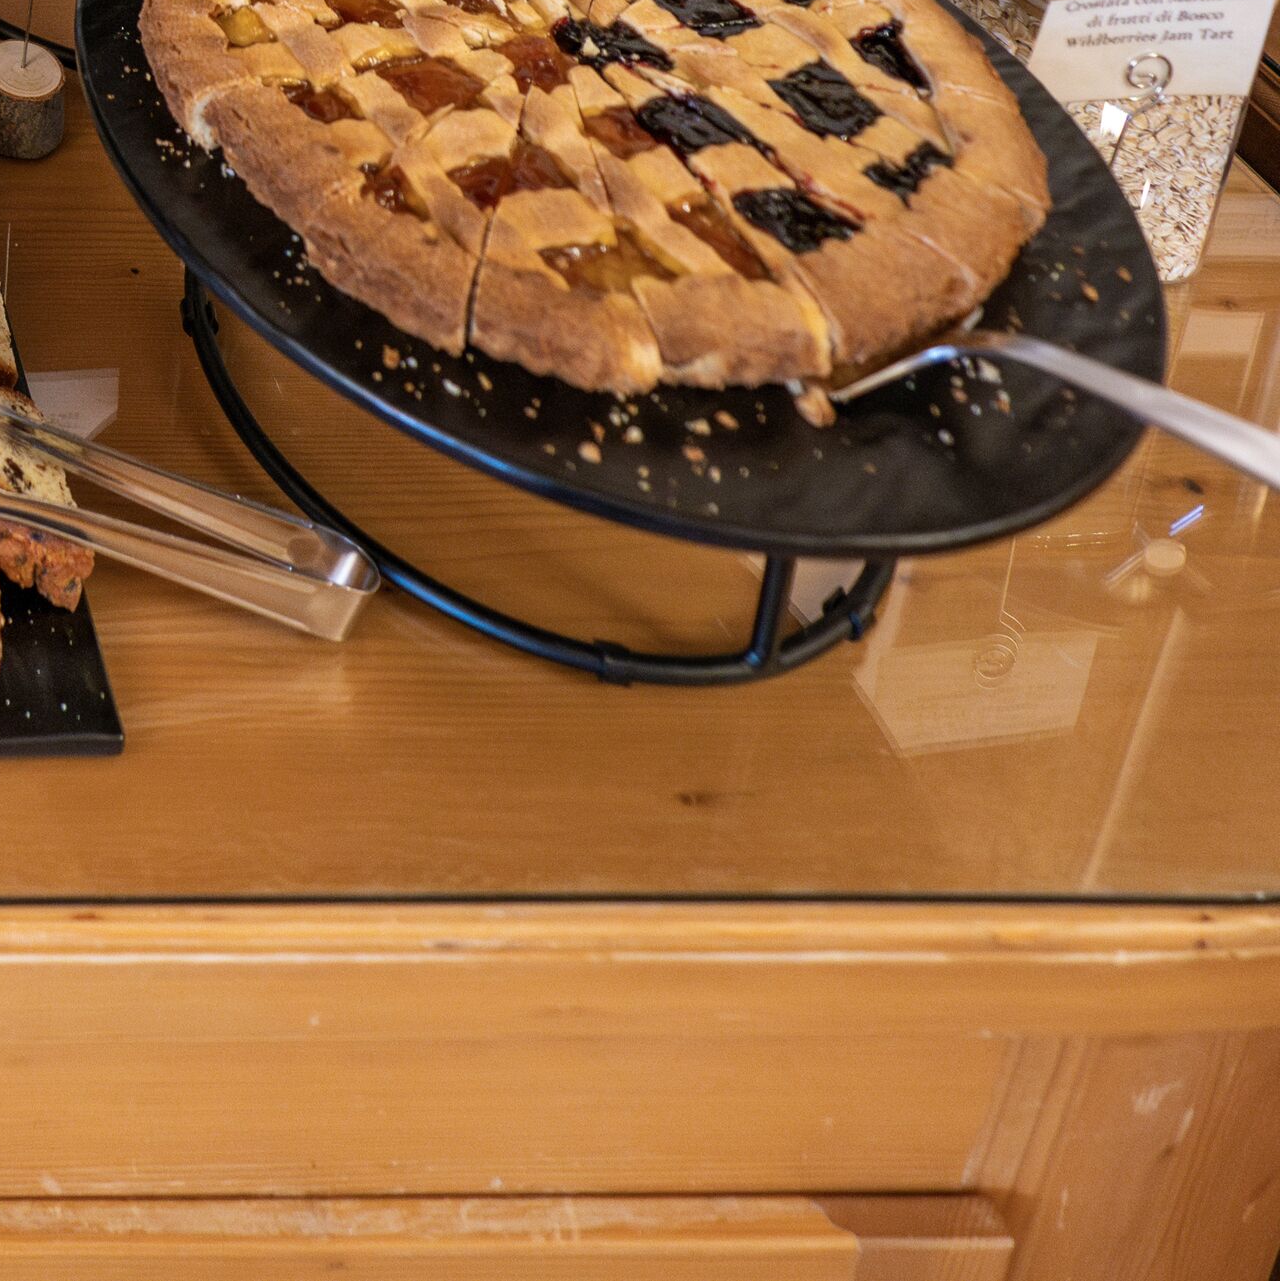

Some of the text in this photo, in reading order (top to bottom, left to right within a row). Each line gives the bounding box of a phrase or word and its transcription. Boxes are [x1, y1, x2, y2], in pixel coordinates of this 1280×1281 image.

[1086, 15, 1103, 28] di
[1156, 12, 1172, 23] di
[1177, 10, 1225, 22] Bosco
[1066, 28, 1235, 48] Wildberries Jam Tart
